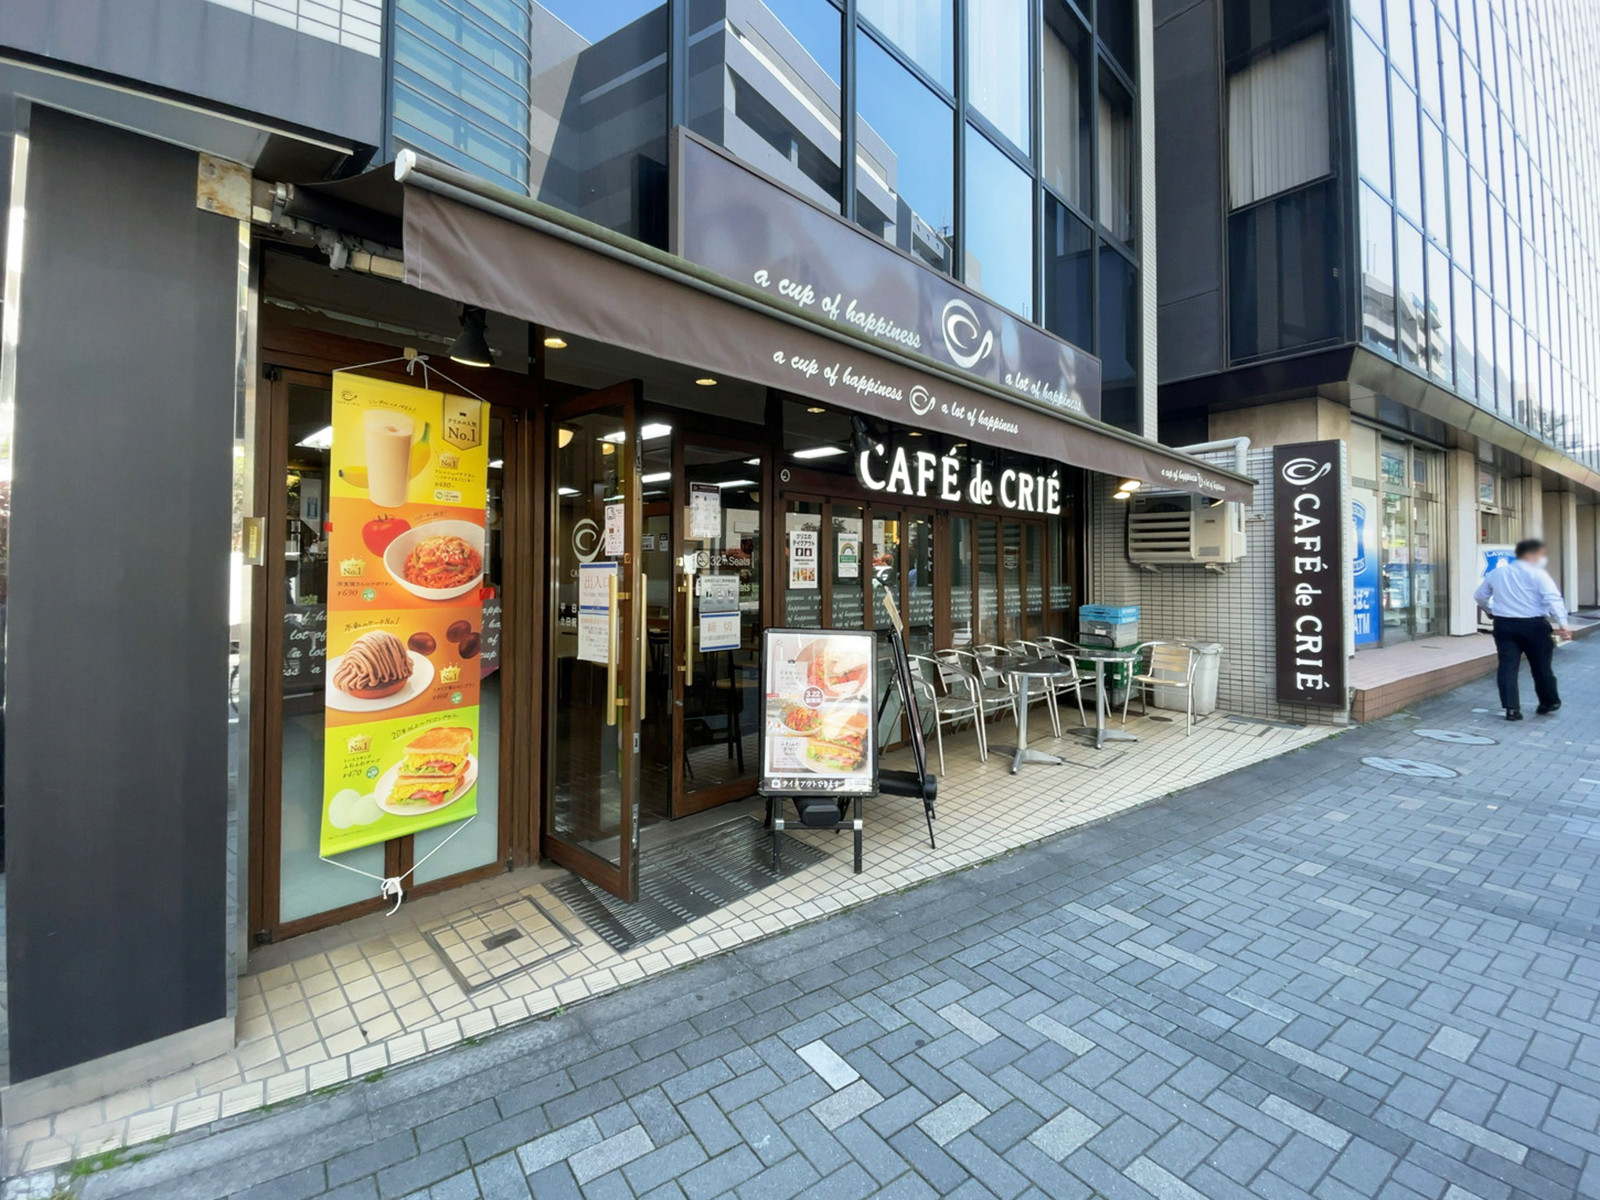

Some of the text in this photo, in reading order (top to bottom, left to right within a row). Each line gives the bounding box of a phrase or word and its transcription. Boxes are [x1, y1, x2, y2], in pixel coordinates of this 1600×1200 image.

[754, 269, 921, 348] a cup of happiness
[773, 351, 903, 401] a cup of happiness
[1005, 371, 1081, 412] a lot of happiness
[941, 402, 1018, 434] a lot of happiness
[448, 427, 475, 442] No.1
[441, 459, 456, 468] No.1
[860, 443, 1061, 515] CAFÉ de CRIÉ
[711, 555, 751, 567] 32 Seats
[343, 567, 361, 575] No.1
[1293, 493, 1330, 691] CAFÉ de CRIÉ
[290, 629, 309, 640] lot
[443, 673, 457, 682] No.1
[806, 690, 820, 698] 3.22
[350, 741, 368, 752] No.1
